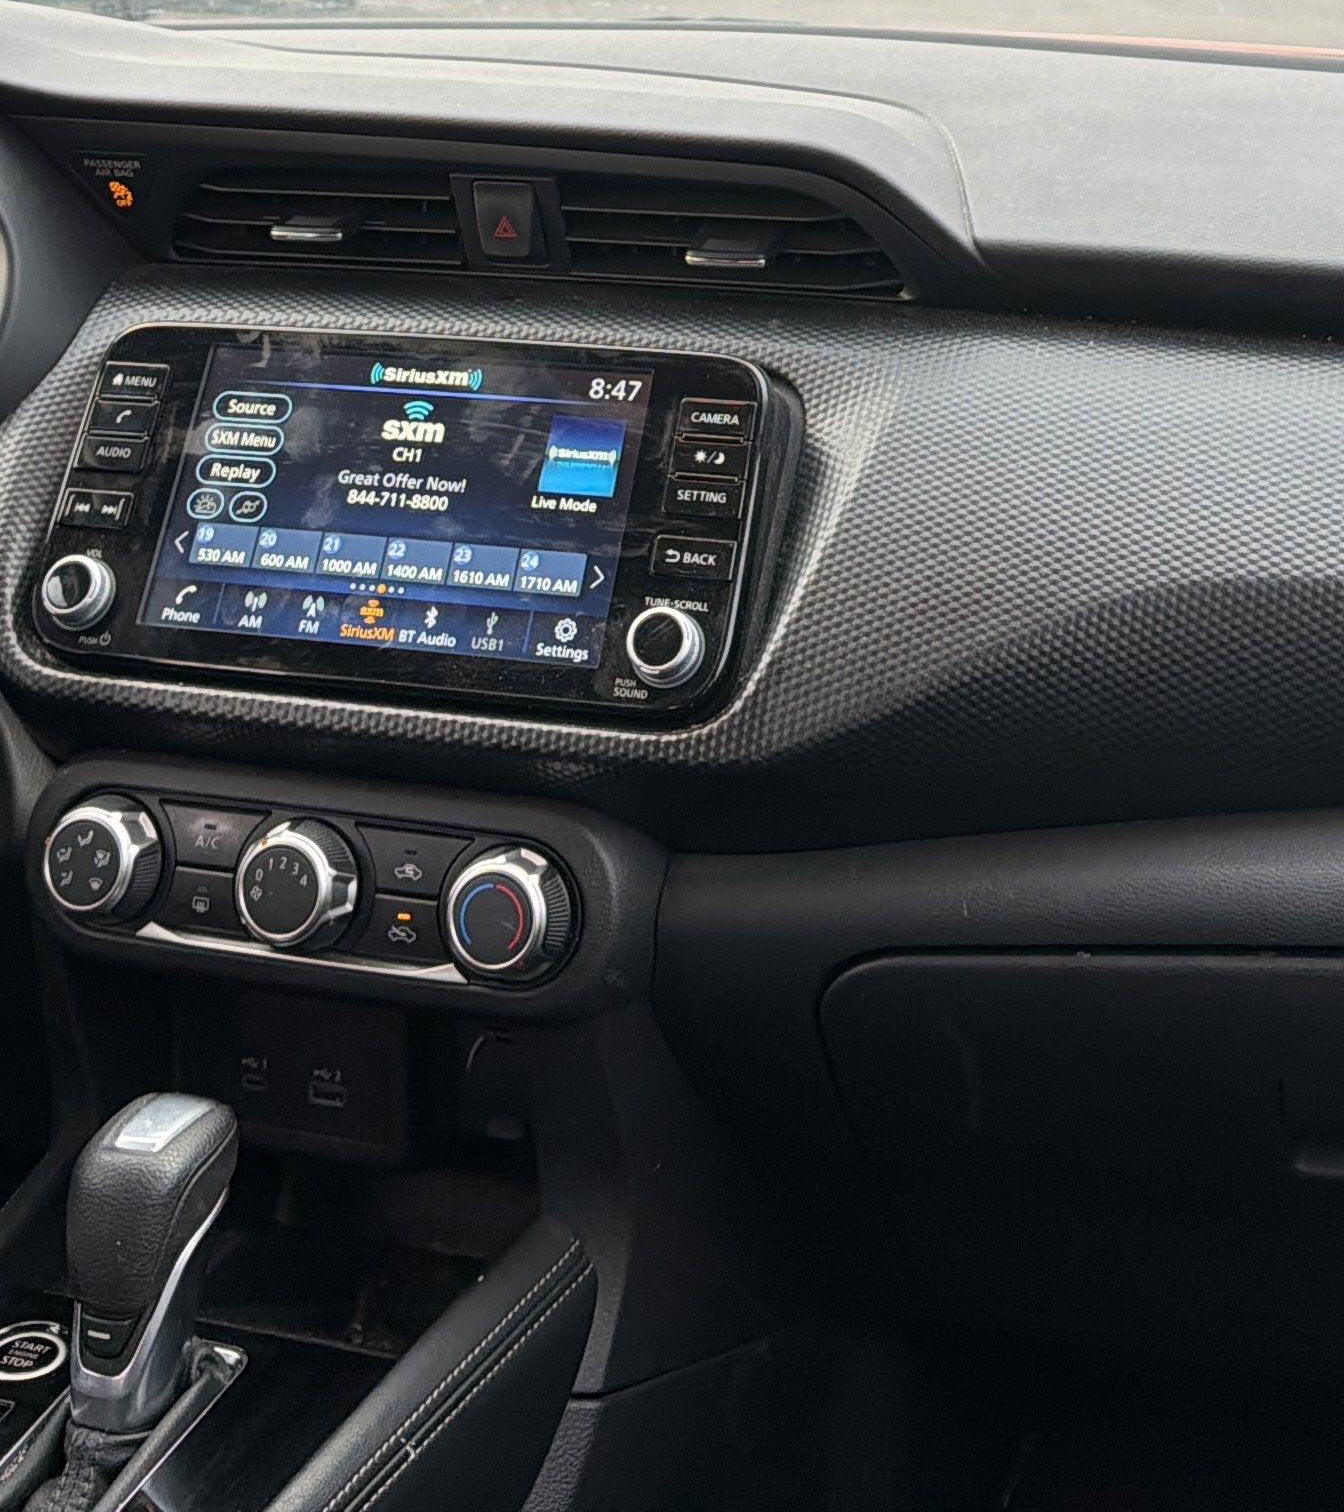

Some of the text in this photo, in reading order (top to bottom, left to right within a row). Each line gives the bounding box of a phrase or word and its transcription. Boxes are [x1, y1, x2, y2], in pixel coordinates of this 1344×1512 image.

[83, 158, 141, 169] PASSENGER
[95, 167, 135, 178] AIR BAG
[123, 375, 158, 388] MENU
[588, 378, 643, 402] 8:47
[227, 398, 276, 416] Source
[690, 411, 740, 426] CAMERA
[211, 428, 276, 448] SXM Menu
[381, 420, 446, 444] sxm
[95, 446, 132, 459] AUDIO
[392, 446, 423, 463] CH1
[210, 462, 261, 483] Replay
[337, 469, 467, 493] Great Offer Now!
[346, 489, 449, 512] 844-711-8800
[676, 489, 727, 504] SETTING
[531, 496, 598, 513] Live Mode
[198, 525, 214, 538] 19
[259, 533, 276, 546] 20
[324, 538, 340, 551] 21
[86, 548, 103, 558] VOL
[197, 548, 246, 564] 530 AM
[387, 542, 405, 556] 22
[454, 547, 472, 561] 23
[260, 553, 309, 569] 600 AM
[520, 554, 539, 568] 24
[682, 551, 718, 566] BACK
[322, 558, 378, 576] 1000 AM
[387, 564, 443, 582] 1400 AM
[453, 570, 510, 587] 1610 AM
[520, 575, 578, 594] 1710 AM
[161, 607, 201, 624] Phone
[237, 615, 263, 629] AM
[298, 619, 320, 634] FM
[339, 623, 395, 642] SiriusXM
[398, 629, 457, 648] BT Audio
[471, 636, 504, 652] USB1
[535, 642, 590, 663] Settings
[614, 677, 637, 687] PUSH
[613, 686, 649, 700] SOUND
[194, 834, 220, 849] A/C
[268, 857, 274, 871] 1
[279, 856, 288, 870] 2
[292, 862, 300, 876] 3
[255, 868, 264, 882] 0
[299, 873, 308, 888] 4
[11, 1340, 52, 1354] START
[0, 1355, 34, 1368] STOP
